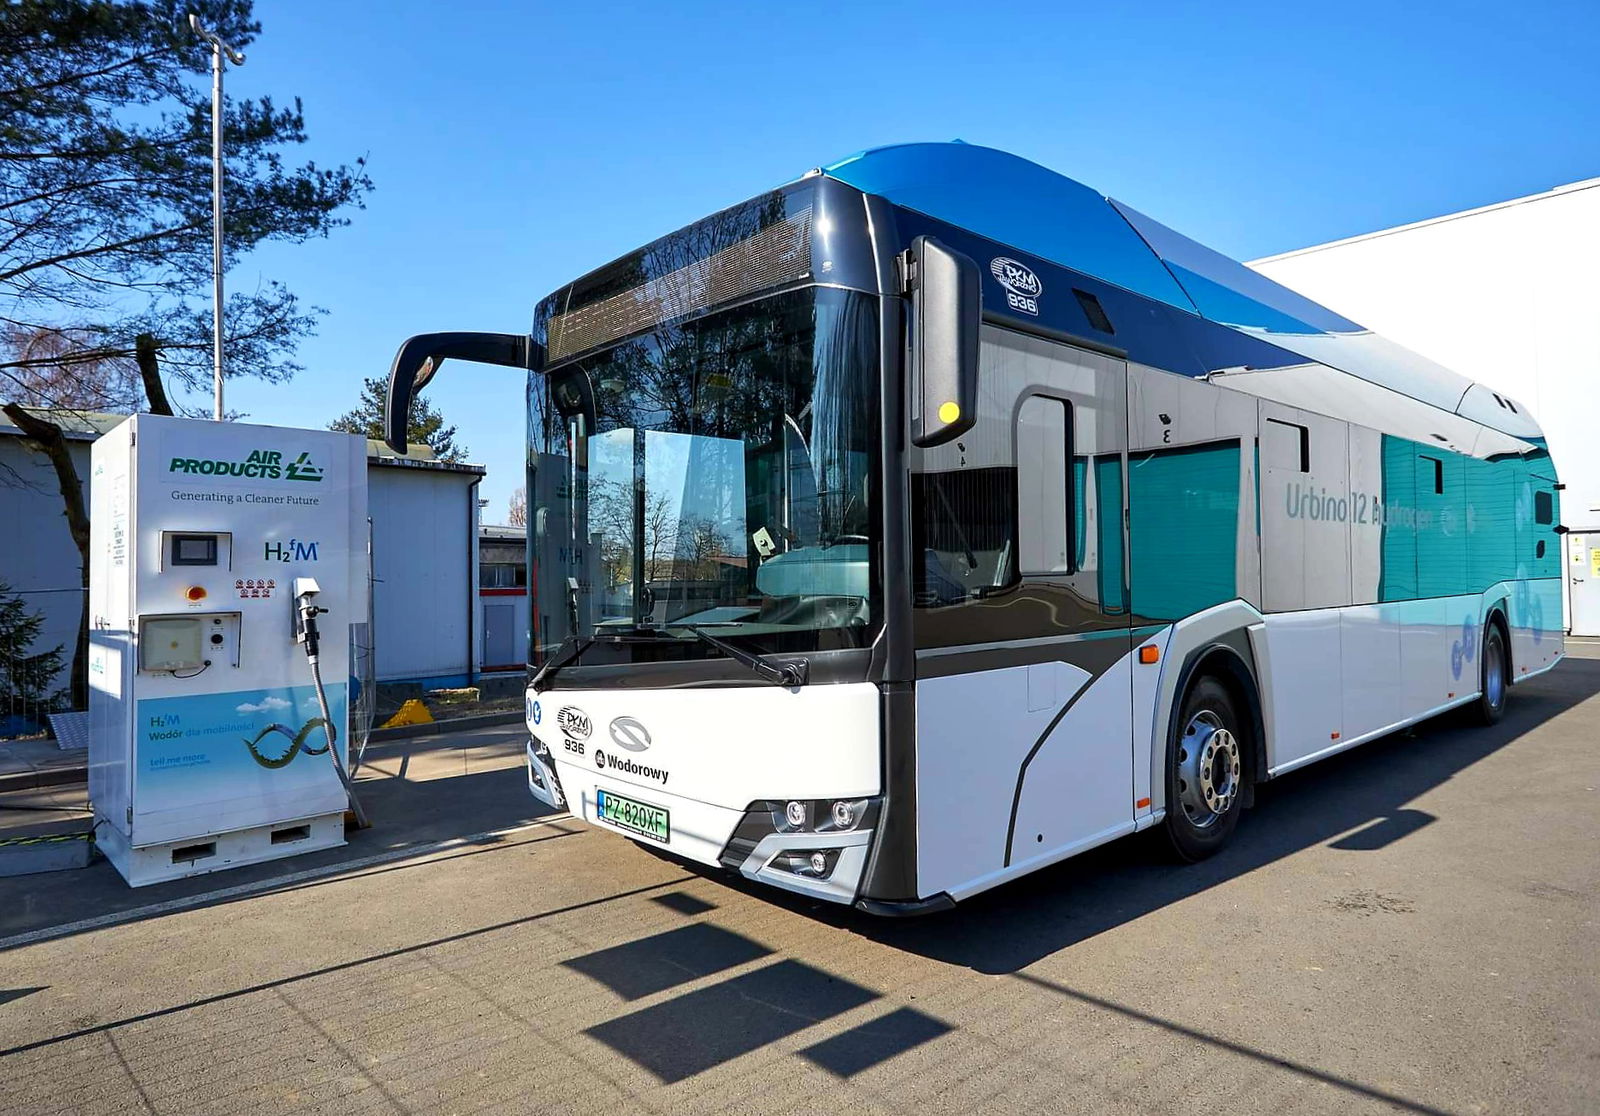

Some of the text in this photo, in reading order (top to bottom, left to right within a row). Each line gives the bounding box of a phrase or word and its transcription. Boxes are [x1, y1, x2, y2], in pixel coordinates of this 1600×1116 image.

[1008, 293, 1036, 312] 936
[246, 449, 282, 465] AIR
[169, 457, 282, 479] PRODUCTS
[171, 490, 320, 506] Generating a Cleaner Future
[1286, 482, 1347, 522] Urbino
[1351, 492, 1367, 524] 12
[149, 729, 183, 741] Wodór
[185, 727, 200, 737] dla
[564, 738, 584, 755] 936
[607, 753, 669, 785] Wodorowy
[605, 796, 620, 820] PZ
[624, 802, 664, 833] 820XF
